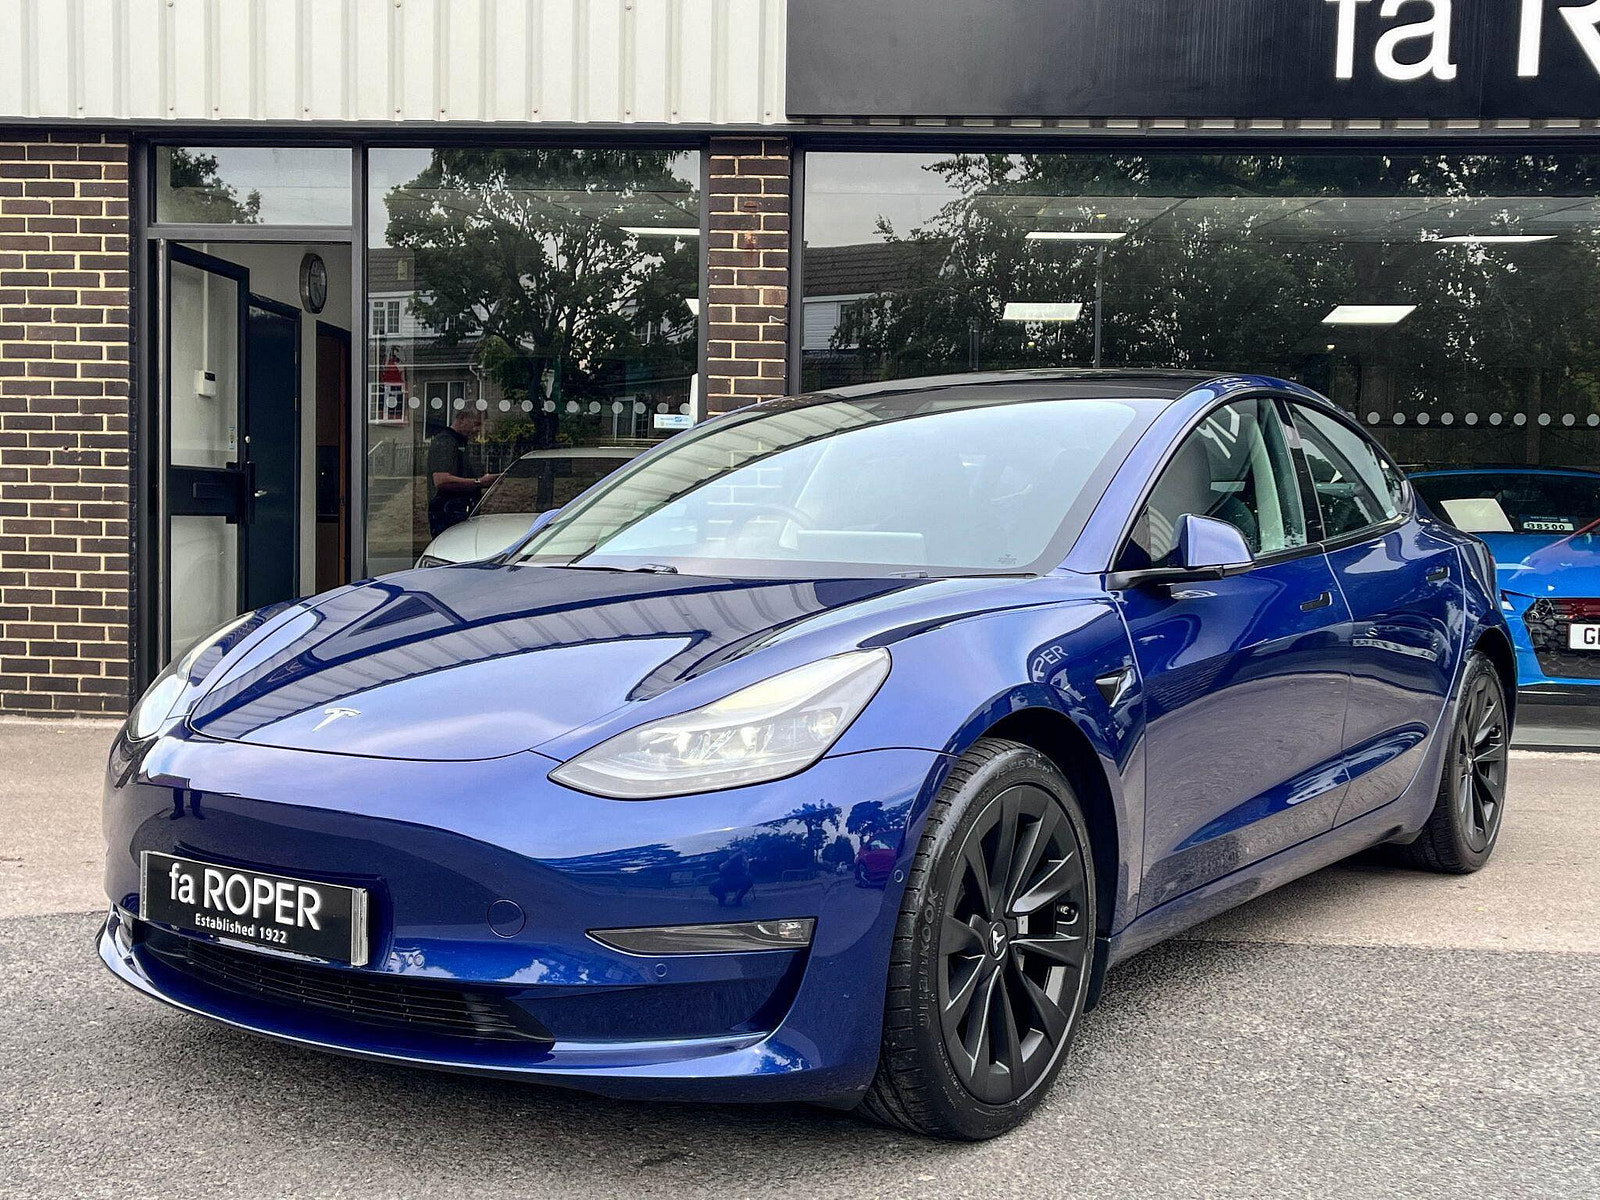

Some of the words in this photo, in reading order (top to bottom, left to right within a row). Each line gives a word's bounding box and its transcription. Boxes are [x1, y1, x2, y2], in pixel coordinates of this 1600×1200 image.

[1583, 627, 1600, 645] G
[169, 862, 195, 905] fa
[203, 868, 322, 930] ROPER
[194, 912, 254, 937] Established
[259, 926, 287, 944] 1922
